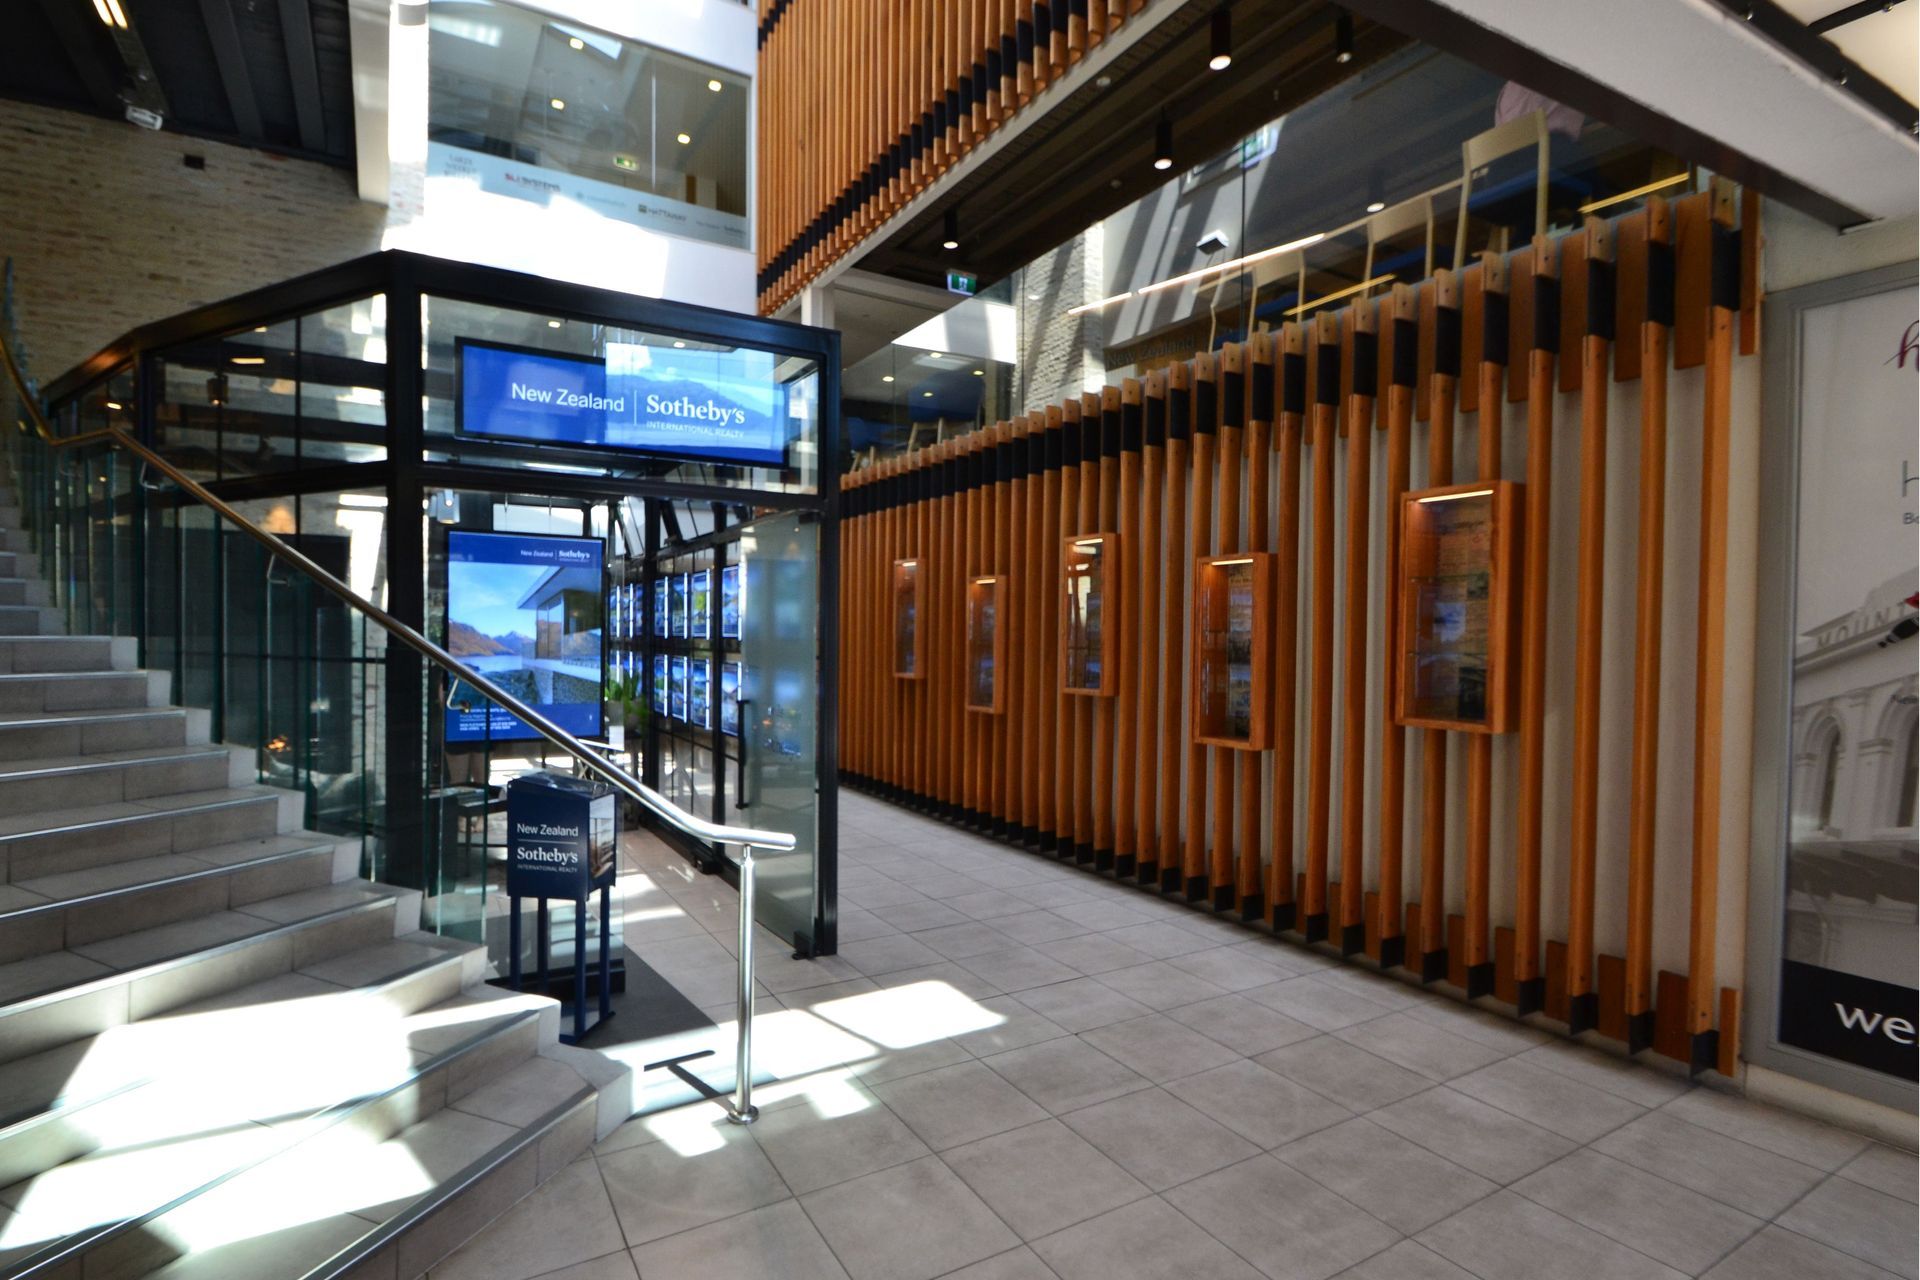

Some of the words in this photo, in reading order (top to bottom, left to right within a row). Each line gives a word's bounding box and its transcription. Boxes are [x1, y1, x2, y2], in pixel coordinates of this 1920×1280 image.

[511, 383, 551, 403] New
[556, 388, 624, 413] Zealand
[646, 394, 745, 426] Sotheby's
[646, 421, 713, 436] INTERNATIONAL
[715, 428, 745, 439] REALTY
[516, 823, 538, 833] New
[540, 824, 578, 836] Zealand
[516, 846, 579, 866] Sotheby's
[517, 864, 558, 873] INTERNATIONAL
